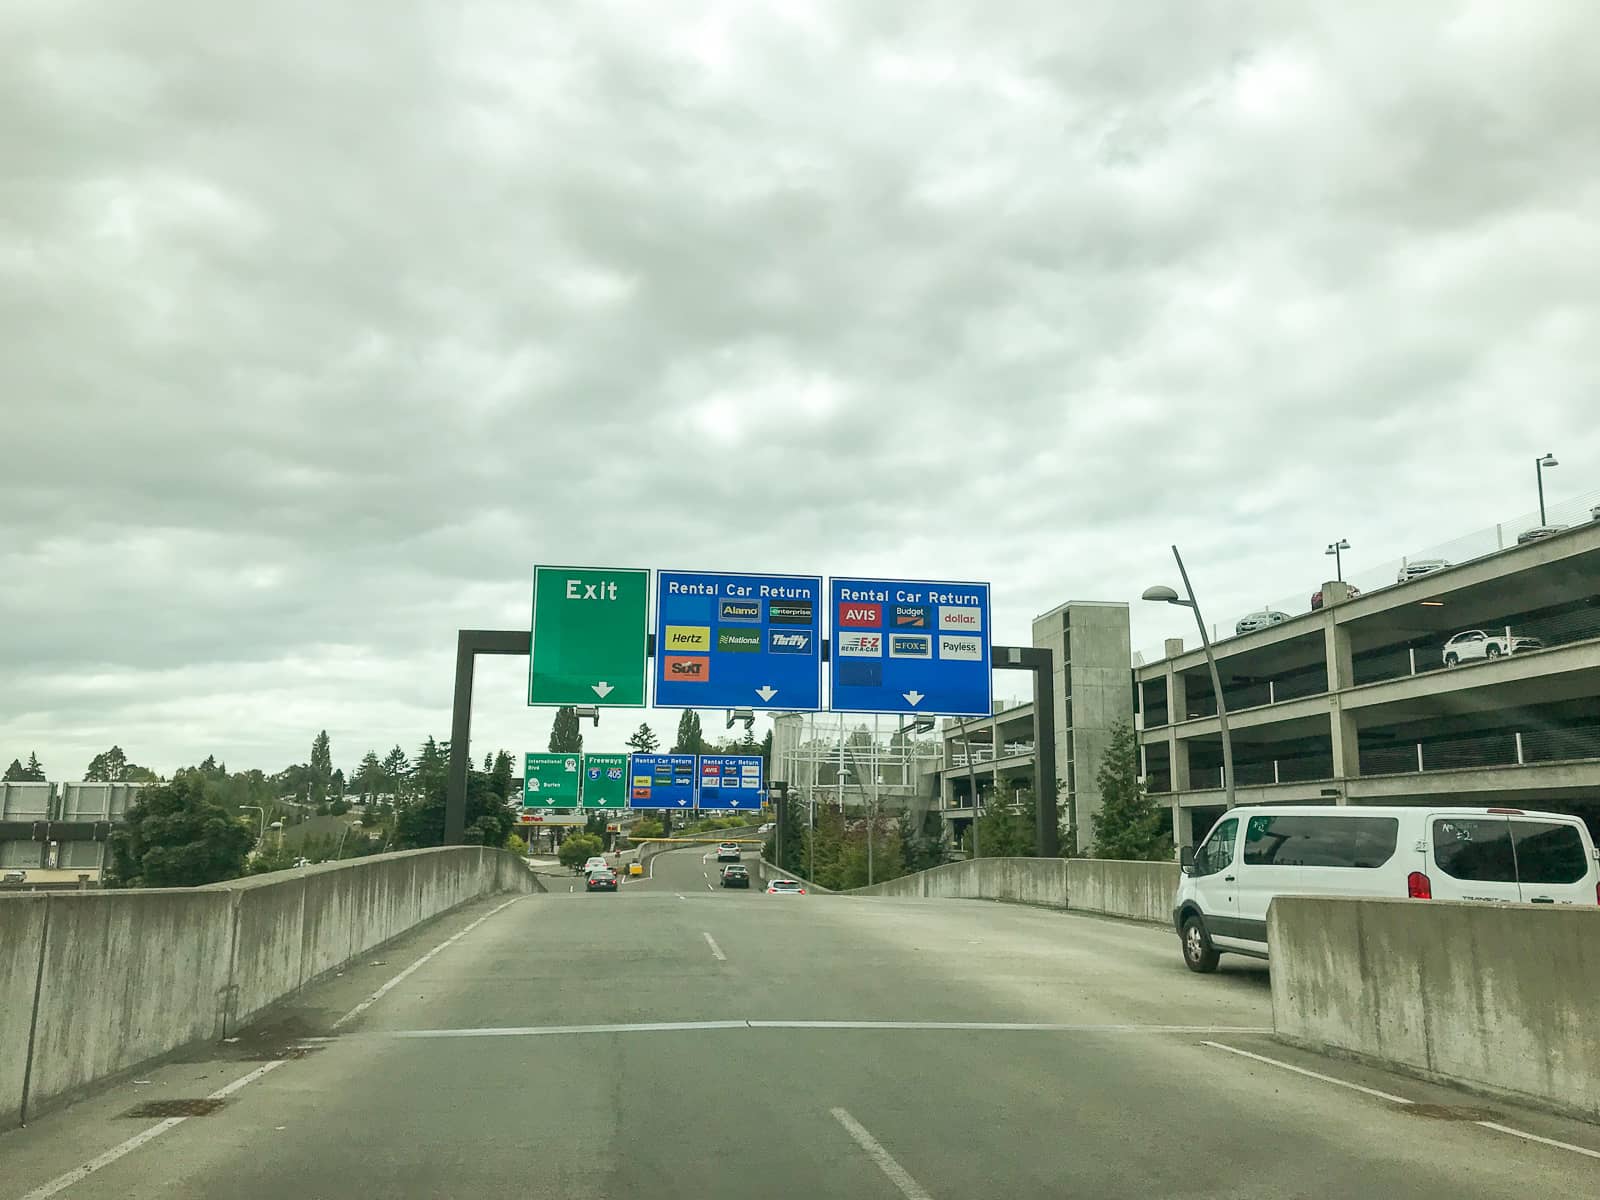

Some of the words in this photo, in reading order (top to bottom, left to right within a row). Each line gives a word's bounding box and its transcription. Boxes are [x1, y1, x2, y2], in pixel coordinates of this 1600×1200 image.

[566, 579, 618, 600] Exit
[669, 582, 718, 596] Rental
[726, 584, 752, 598] Car
[760, 586, 811, 599] Return
[841, 588, 889, 602] Rental
[896, 591, 922, 603] Car
[929, 592, 979, 605] Return
[723, 606, 758, 616] Alamo
[770, 608, 811, 616] enterprise
[845, 609, 876, 621] AVIS
[896, 607, 924, 617] Budget
[672, 633, 703, 644] Hertz
[728, 635, 760, 645] National
[773, 634, 809, 649] Thrifty
[902, 642, 920, 650] FOX
[943, 642, 977, 654] Payless
[589, 757, 622, 765] Freeways
[591, 771, 598, 779] 5
[607, 771, 622, 779] 405
